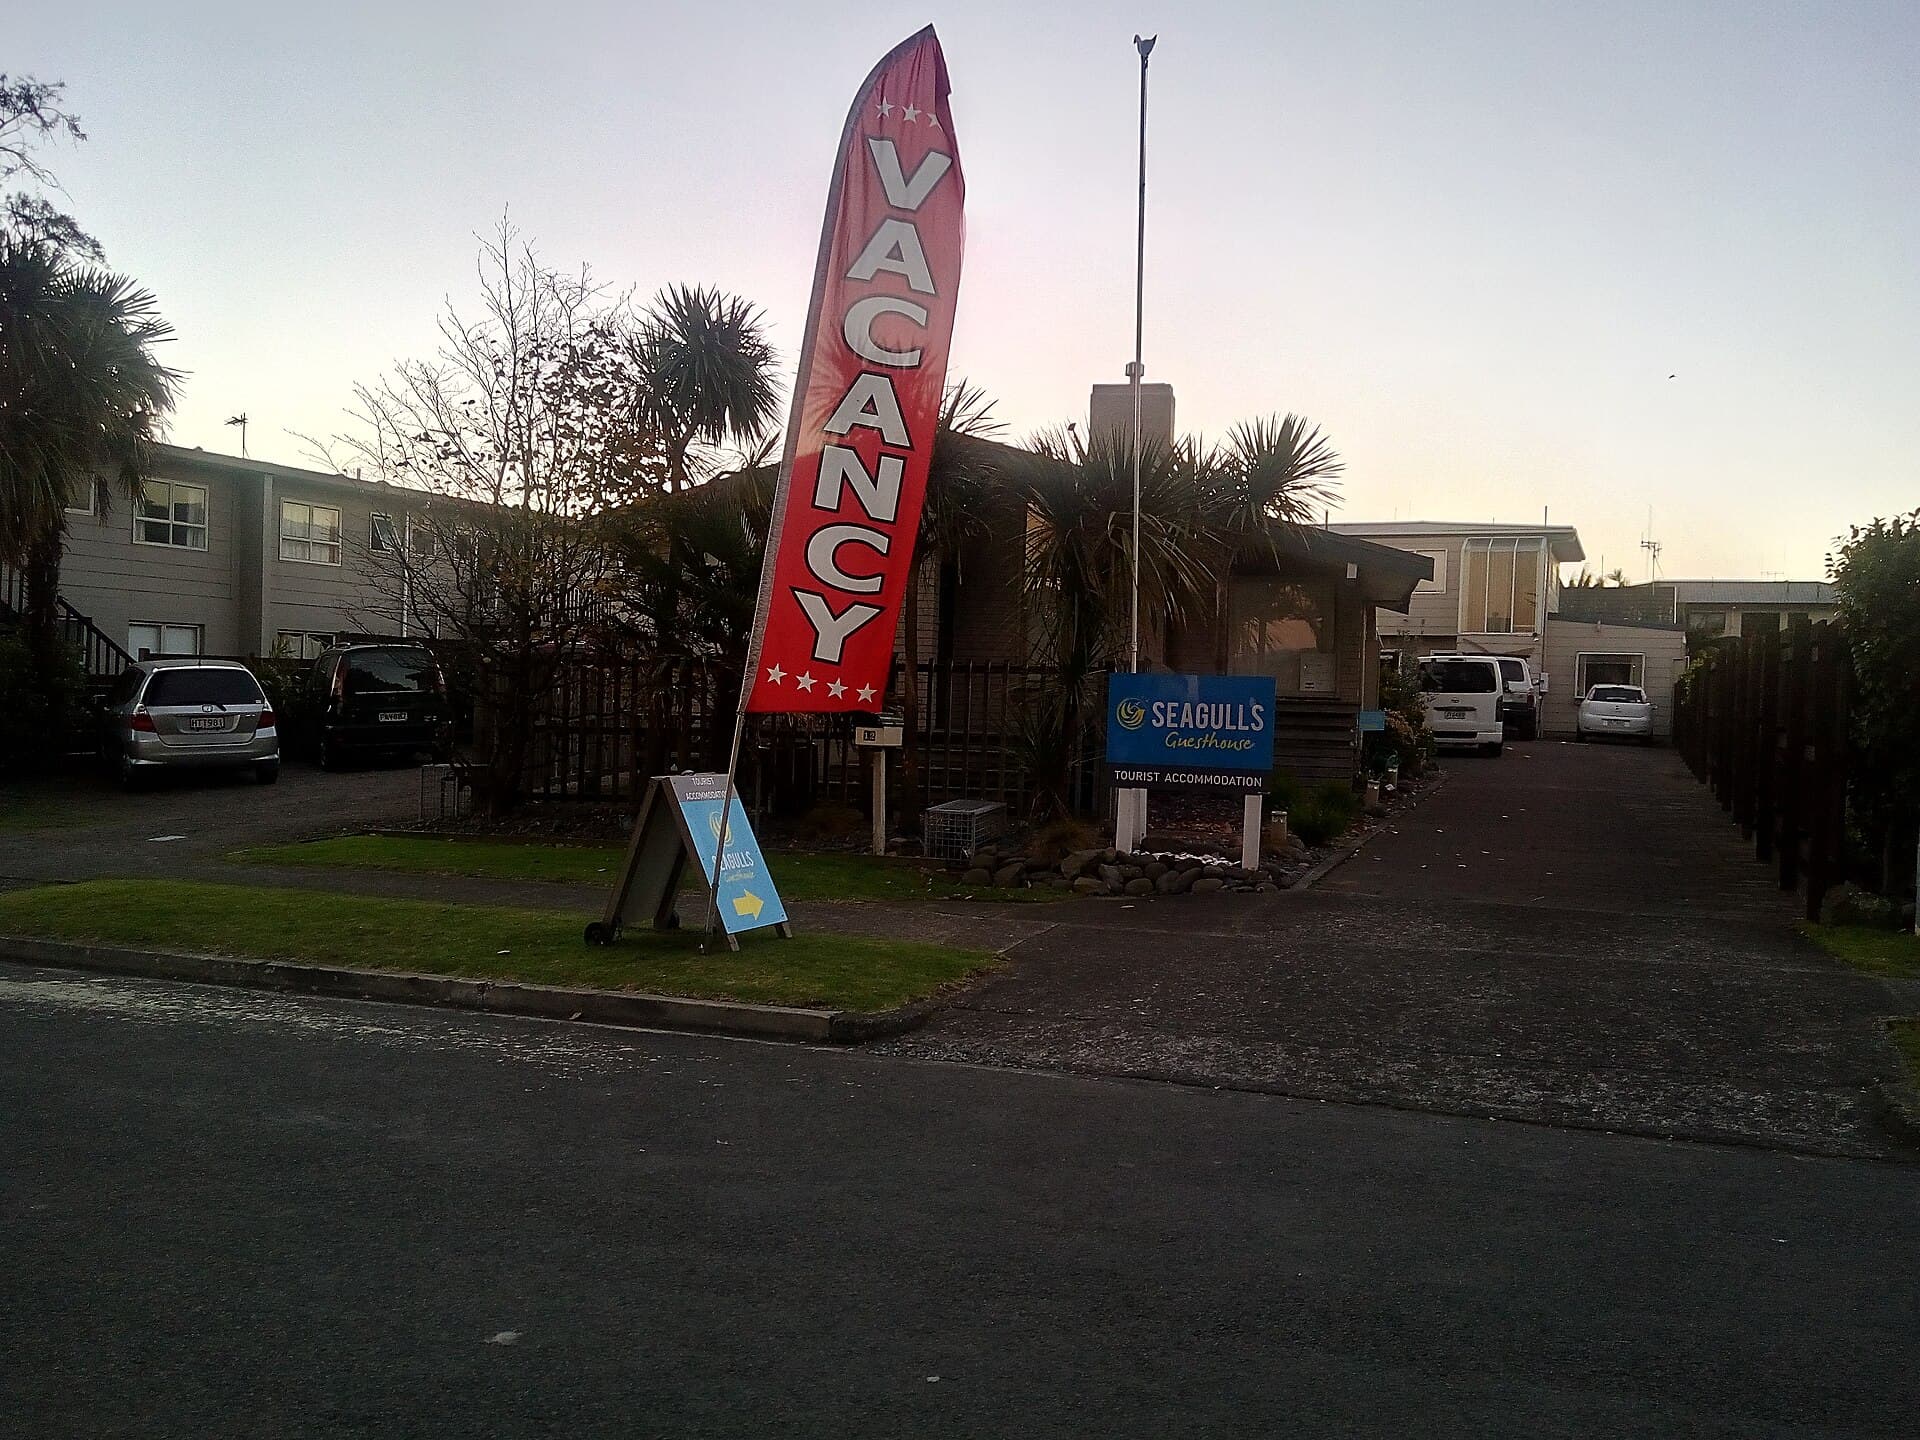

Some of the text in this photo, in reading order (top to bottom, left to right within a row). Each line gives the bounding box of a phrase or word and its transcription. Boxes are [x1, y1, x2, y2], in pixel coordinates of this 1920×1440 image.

[792, 136, 953, 665] VACANCY
[864, 732, 875, 740] 12
[1165, 731, 1255, 750] Guesthouse
[1115, 770, 1262, 787] TOURIST ACCOMMODATION
[685, 789, 727, 801] ACCOMMODATIO
